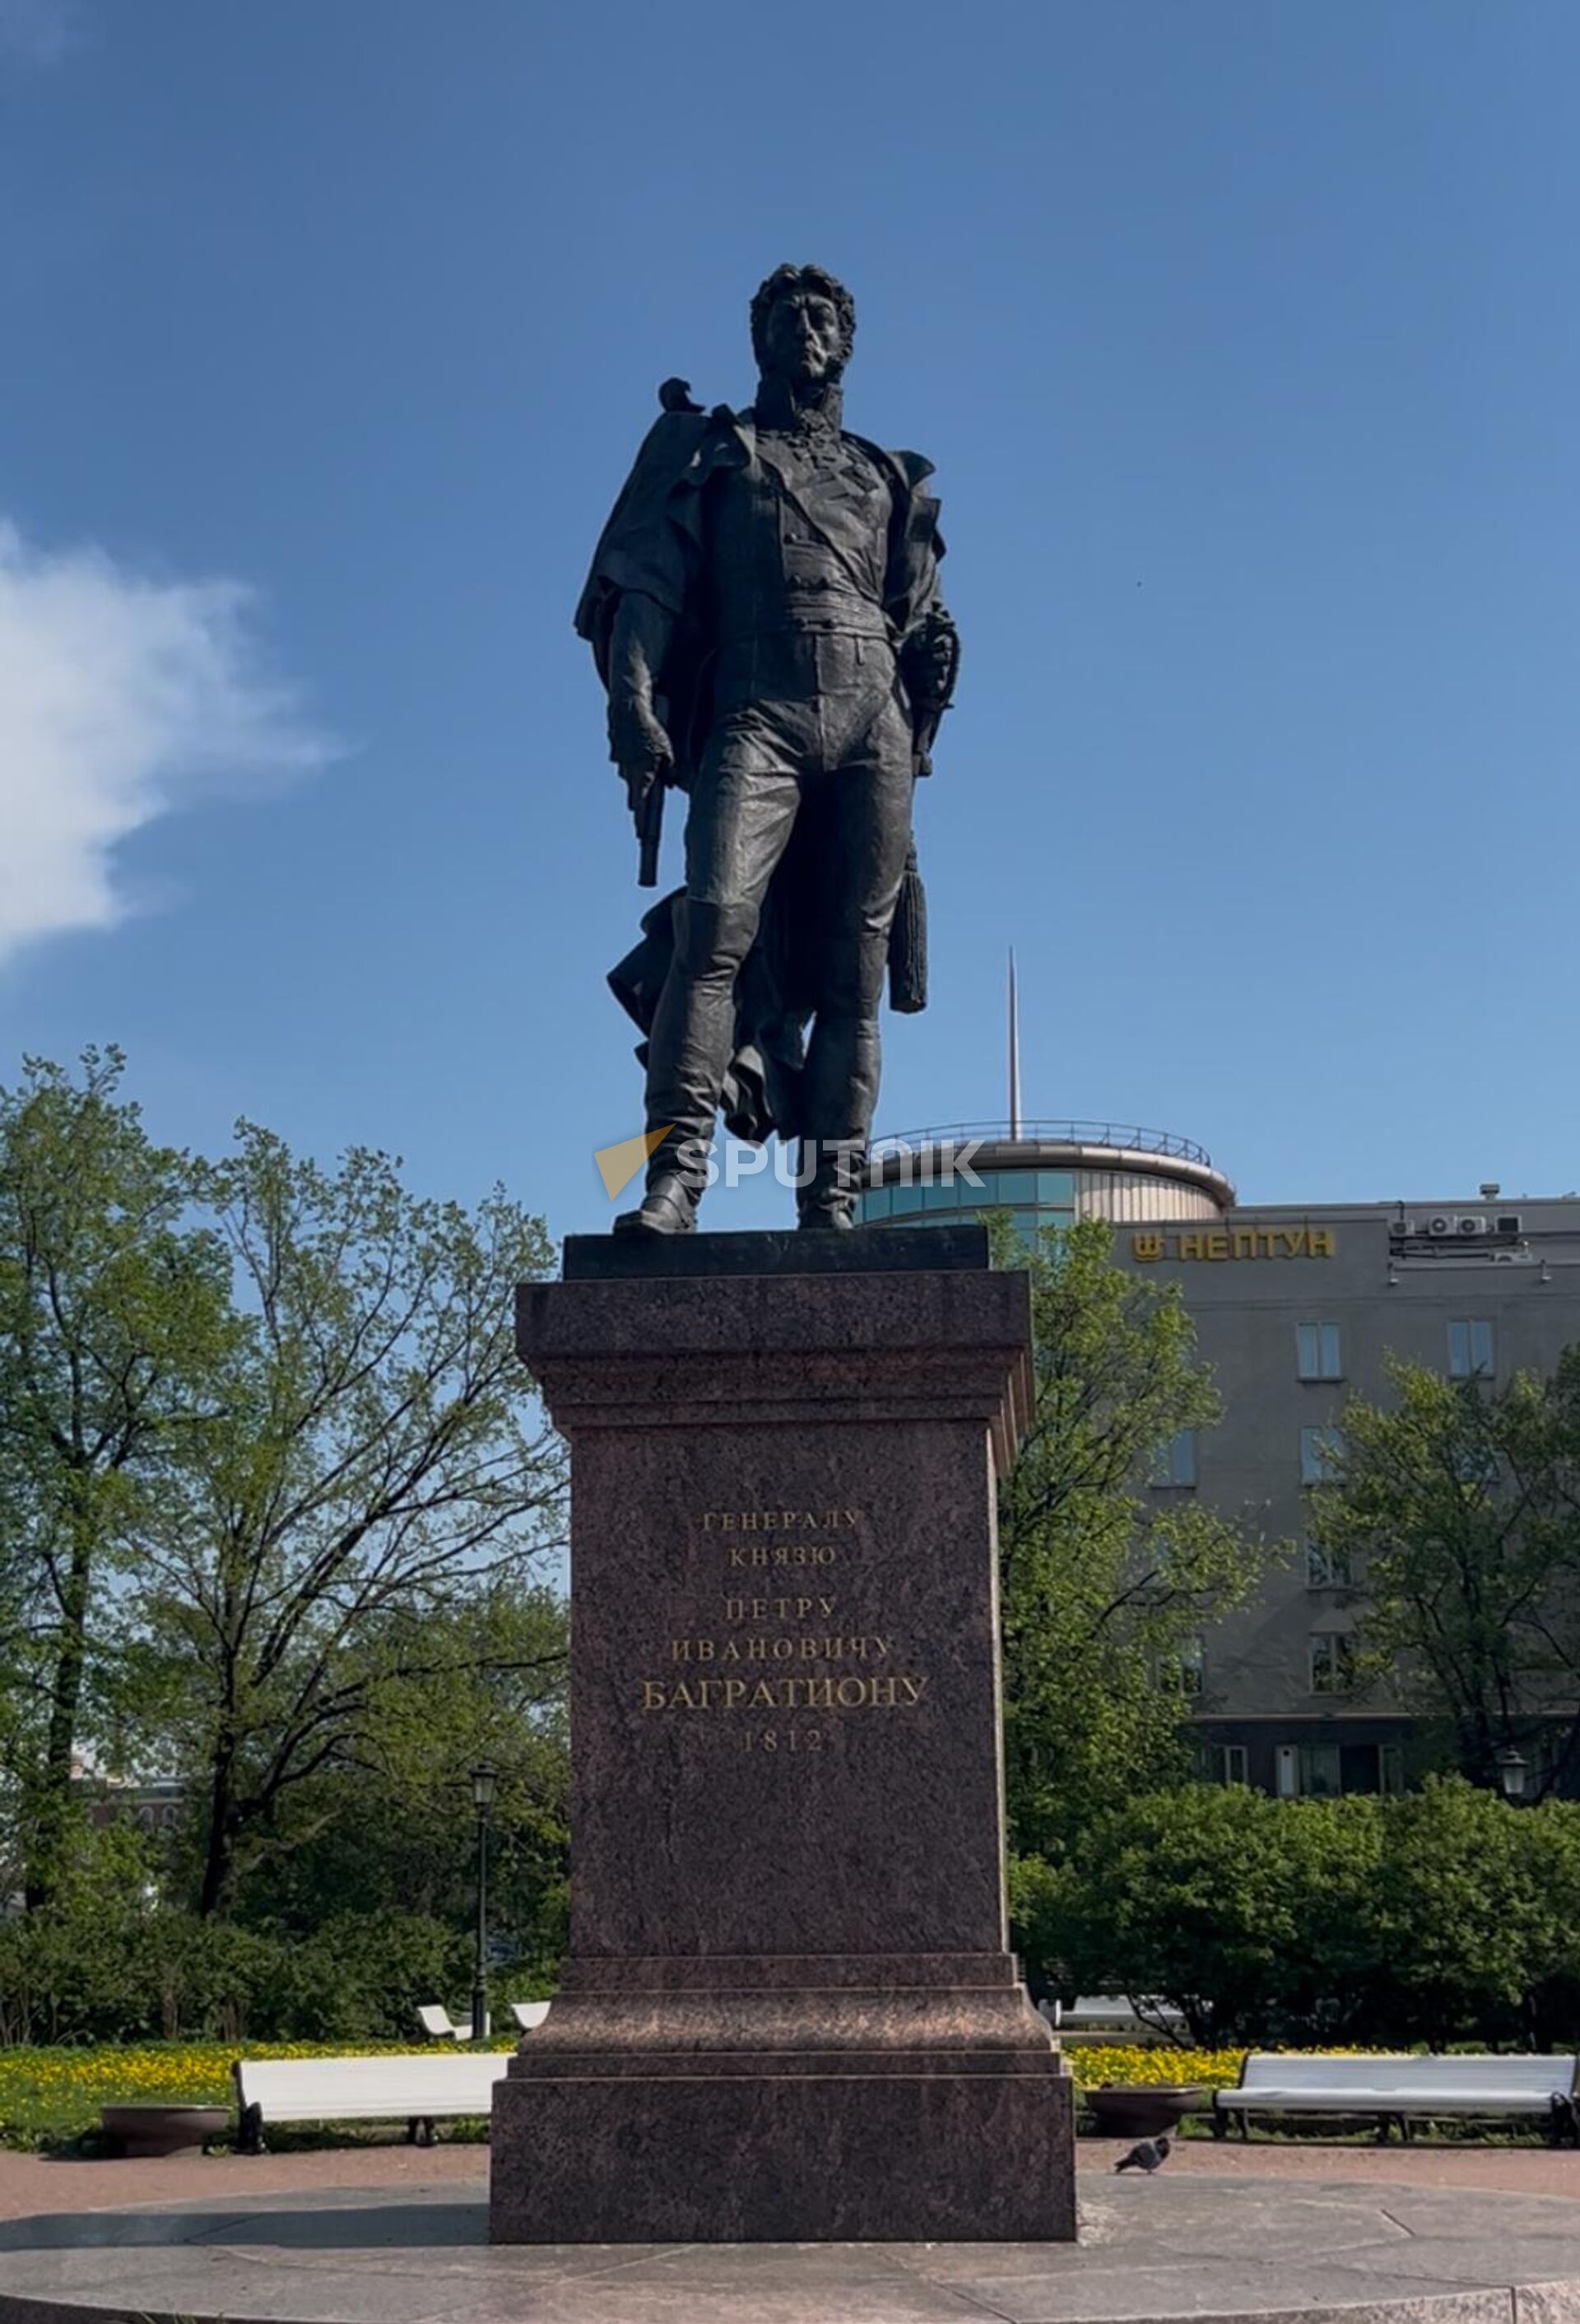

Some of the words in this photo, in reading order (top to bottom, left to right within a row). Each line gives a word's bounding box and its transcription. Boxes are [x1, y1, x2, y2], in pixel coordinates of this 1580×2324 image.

[1179, 1229, 1336, 1260] НЕПТУН
[703, 1509, 861, 1531] ГЕНЕРАЛУ
[728, 1545, 837, 1566] КНЯЗЮ
[726, 1597, 838, 1620] ПЕТРУ
[671, 1637, 895, 1661] ИВАНОВИЧУ
[641, 1676, 929, 1710] БАГРАТИОНУ
[744, 1730, 823, 1752] 1812
